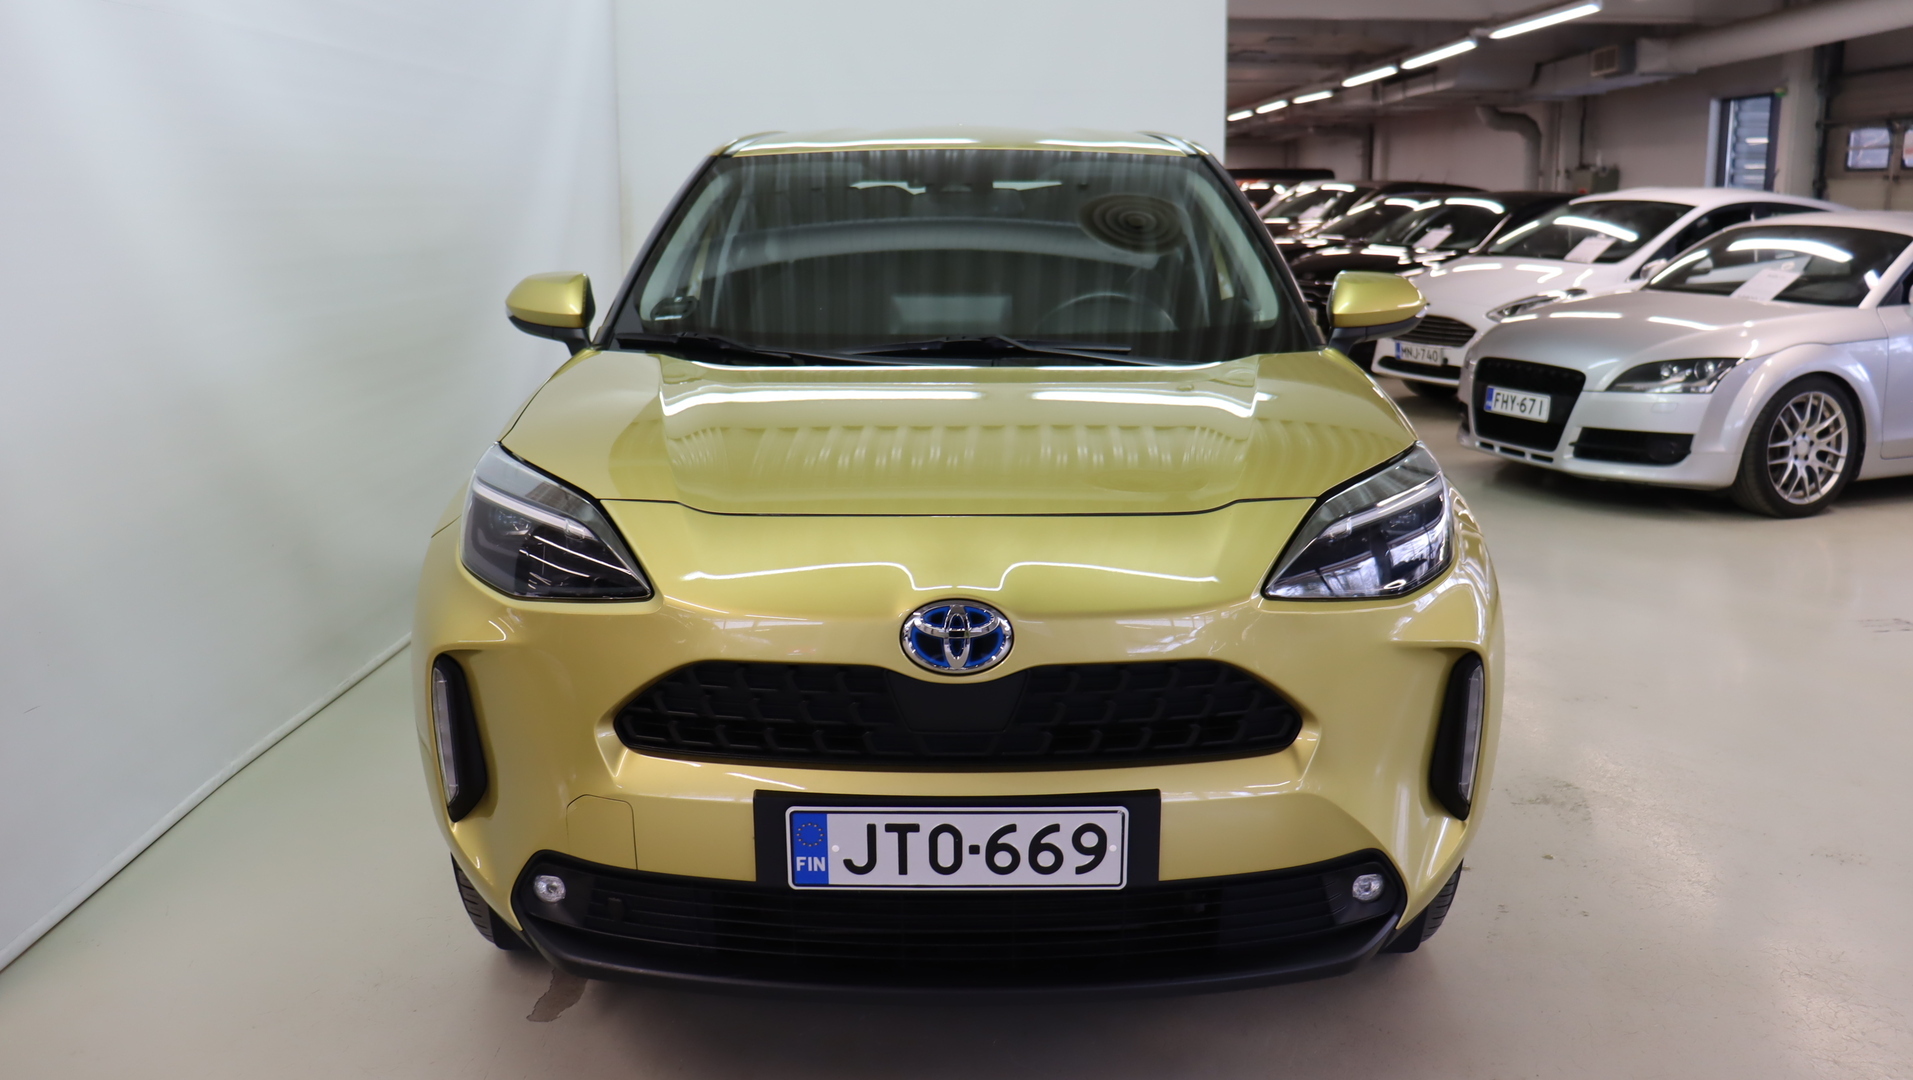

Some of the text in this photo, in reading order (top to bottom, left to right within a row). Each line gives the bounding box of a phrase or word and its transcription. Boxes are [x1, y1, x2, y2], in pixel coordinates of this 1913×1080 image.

[1401, 346, 1438, 362] MNJ-740
[1493, 392, 1544, 417] FHY-671
[843, 823, 1108, 875] JTO-669
[796, 856, 826, 872] FIN
